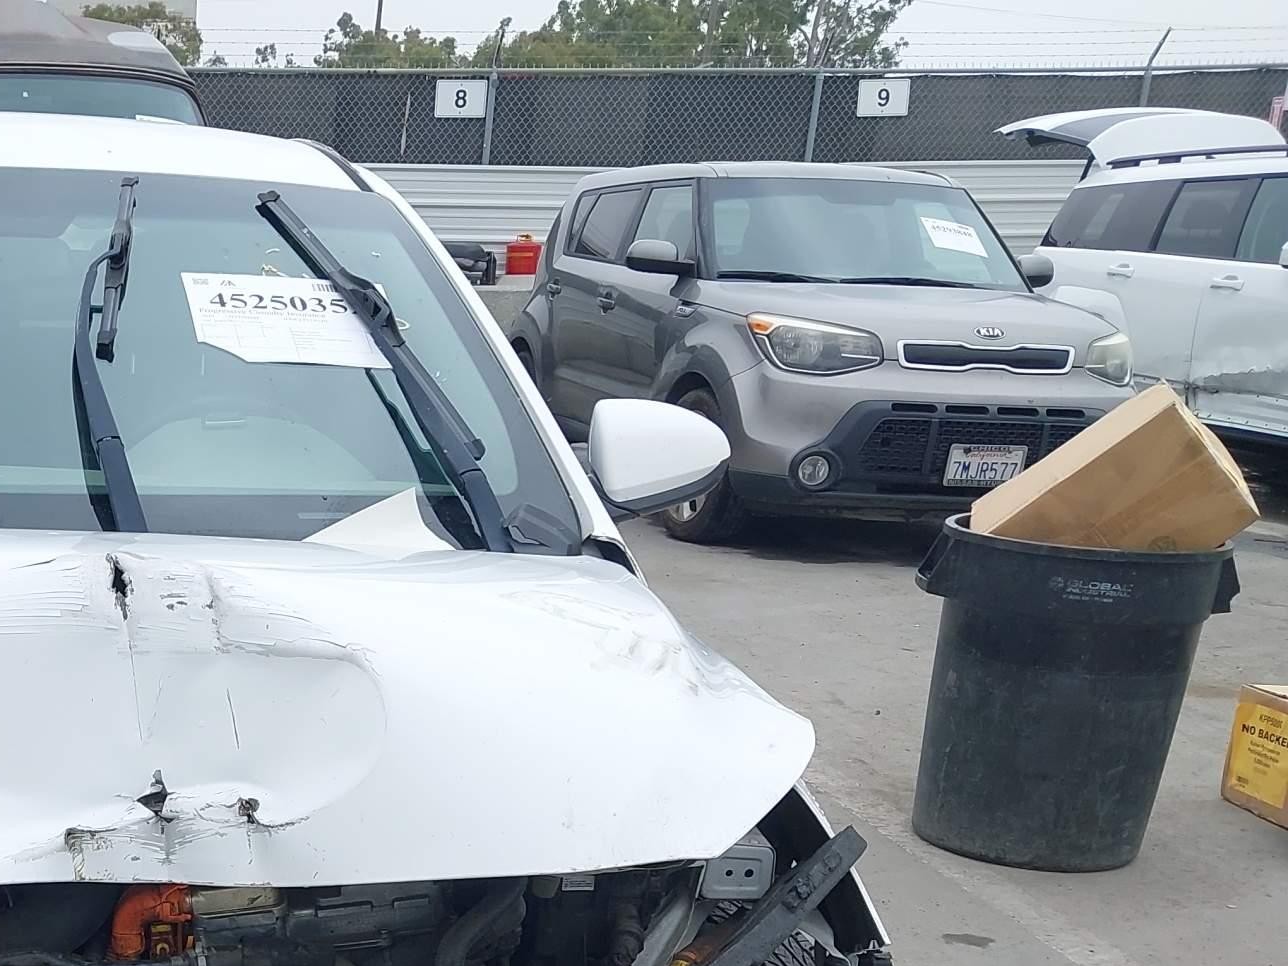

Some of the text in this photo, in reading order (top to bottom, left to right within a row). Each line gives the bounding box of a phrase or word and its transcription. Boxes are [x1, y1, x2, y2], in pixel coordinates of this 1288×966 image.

[455, 89, 467, 108] 8
[877, 88, 890, 107] 9
[210, 293, 357, 314] 4525035
[979, 327, 1002, 337] KIA
[953, 461, 1018, 479] 7MJR577
[1241, 723, 1256, 736] NO
